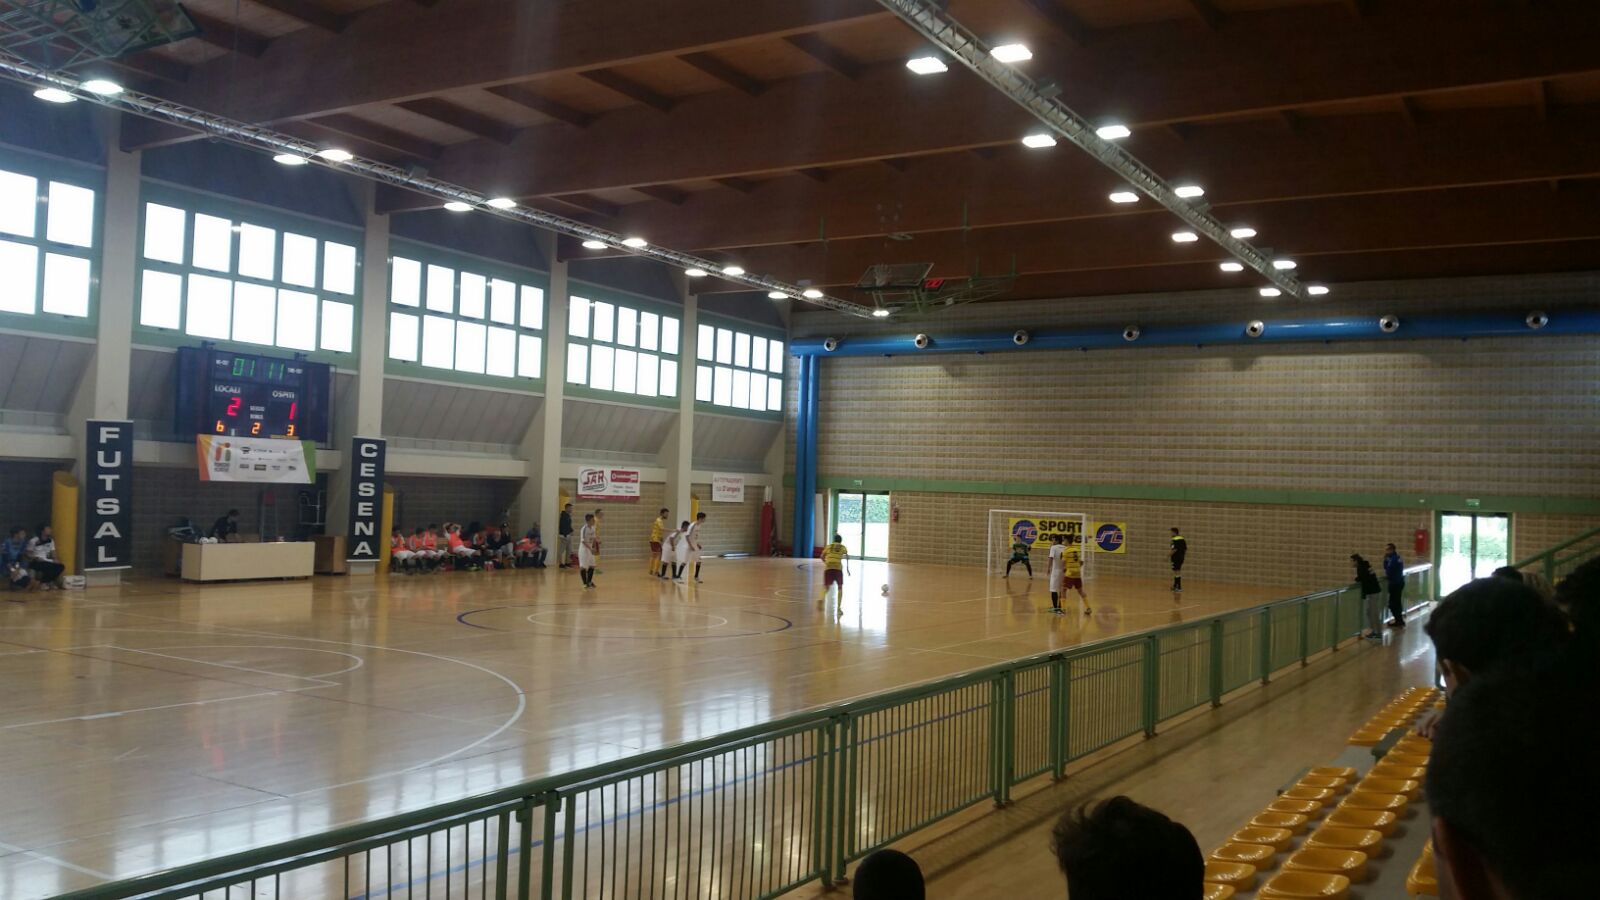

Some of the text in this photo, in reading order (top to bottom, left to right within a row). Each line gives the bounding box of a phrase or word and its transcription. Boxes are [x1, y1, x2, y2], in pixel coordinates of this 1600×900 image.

[232, 358, 285, 381] 01 11
[214, 384, 241, 394] LOCALI
[271, 390, 295, 399] OSPITI
[227, 397, 241, 416] 2
[289, 402, 296, 420] 1
[216, 420, 225, 432] 6
[251, 421, 261, 435] 2
[287, 424, 295, 436] 3
[94, 427, 122, 563] FUTSAL
[353, 443, 378, 556] CESENA
[1039, 520, 1083, 532] SPORT
